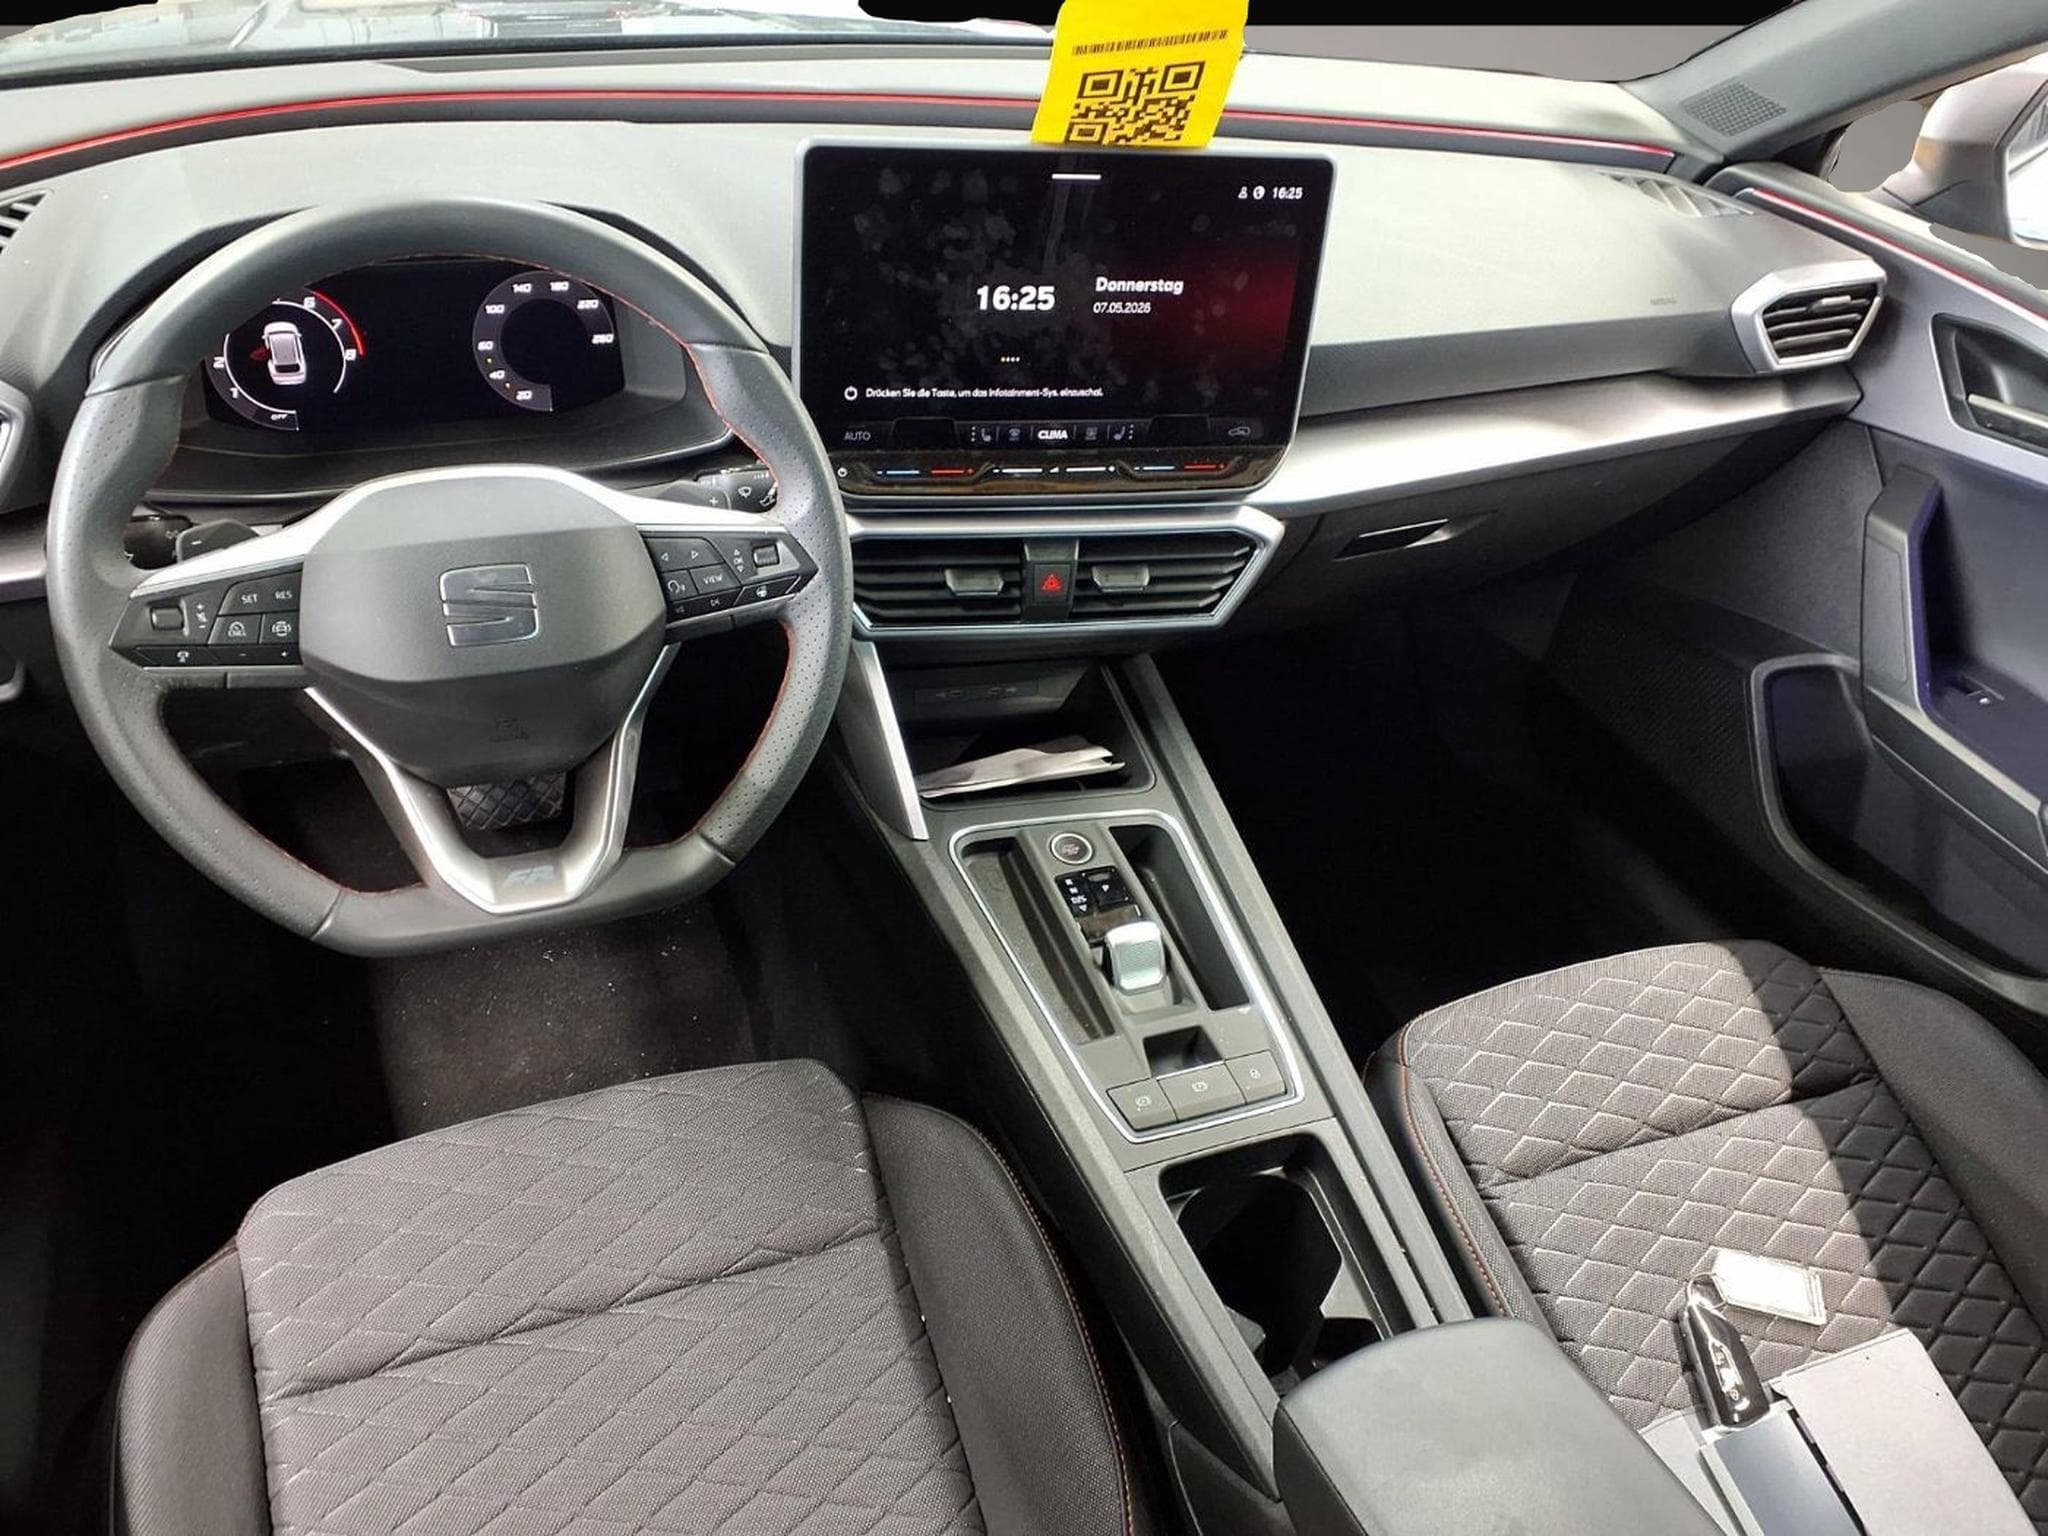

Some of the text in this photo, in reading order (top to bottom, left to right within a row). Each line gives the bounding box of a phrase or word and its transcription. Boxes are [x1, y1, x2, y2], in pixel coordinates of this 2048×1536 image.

[1273, 187, 1303, 199] 16:25
[513, 283, 532, 293] 140
[1095, 276, 1184, 295] Donnerstag
[976, 285, 1055, 311] 16:25
[485, 304, 505, 314] 100
[1093, 302, 1151, 314] 07.05.2026
[213, 356, 226, 368] 2
[489, 370, 505, 380] 40
[230, 387, 239, 398] 1
[516, 390, 532, 401] 20
[865, 387, 901, 398] Drücken
[902, 387, 916, 398] Sie
[917, 387, 930, 398] die
[931, 387, 957, 399] Taste,
[958, 389, 971, 398] um
[972, 388, 987, 398] das
[844, 431, 871, 441] AUTO
[1037, 429, 1069, 441] CLIMA
[703, 573, 723, 585] VIEW
[241, 593, 258, 604] SET
[275, 590, 293, 600] RES
